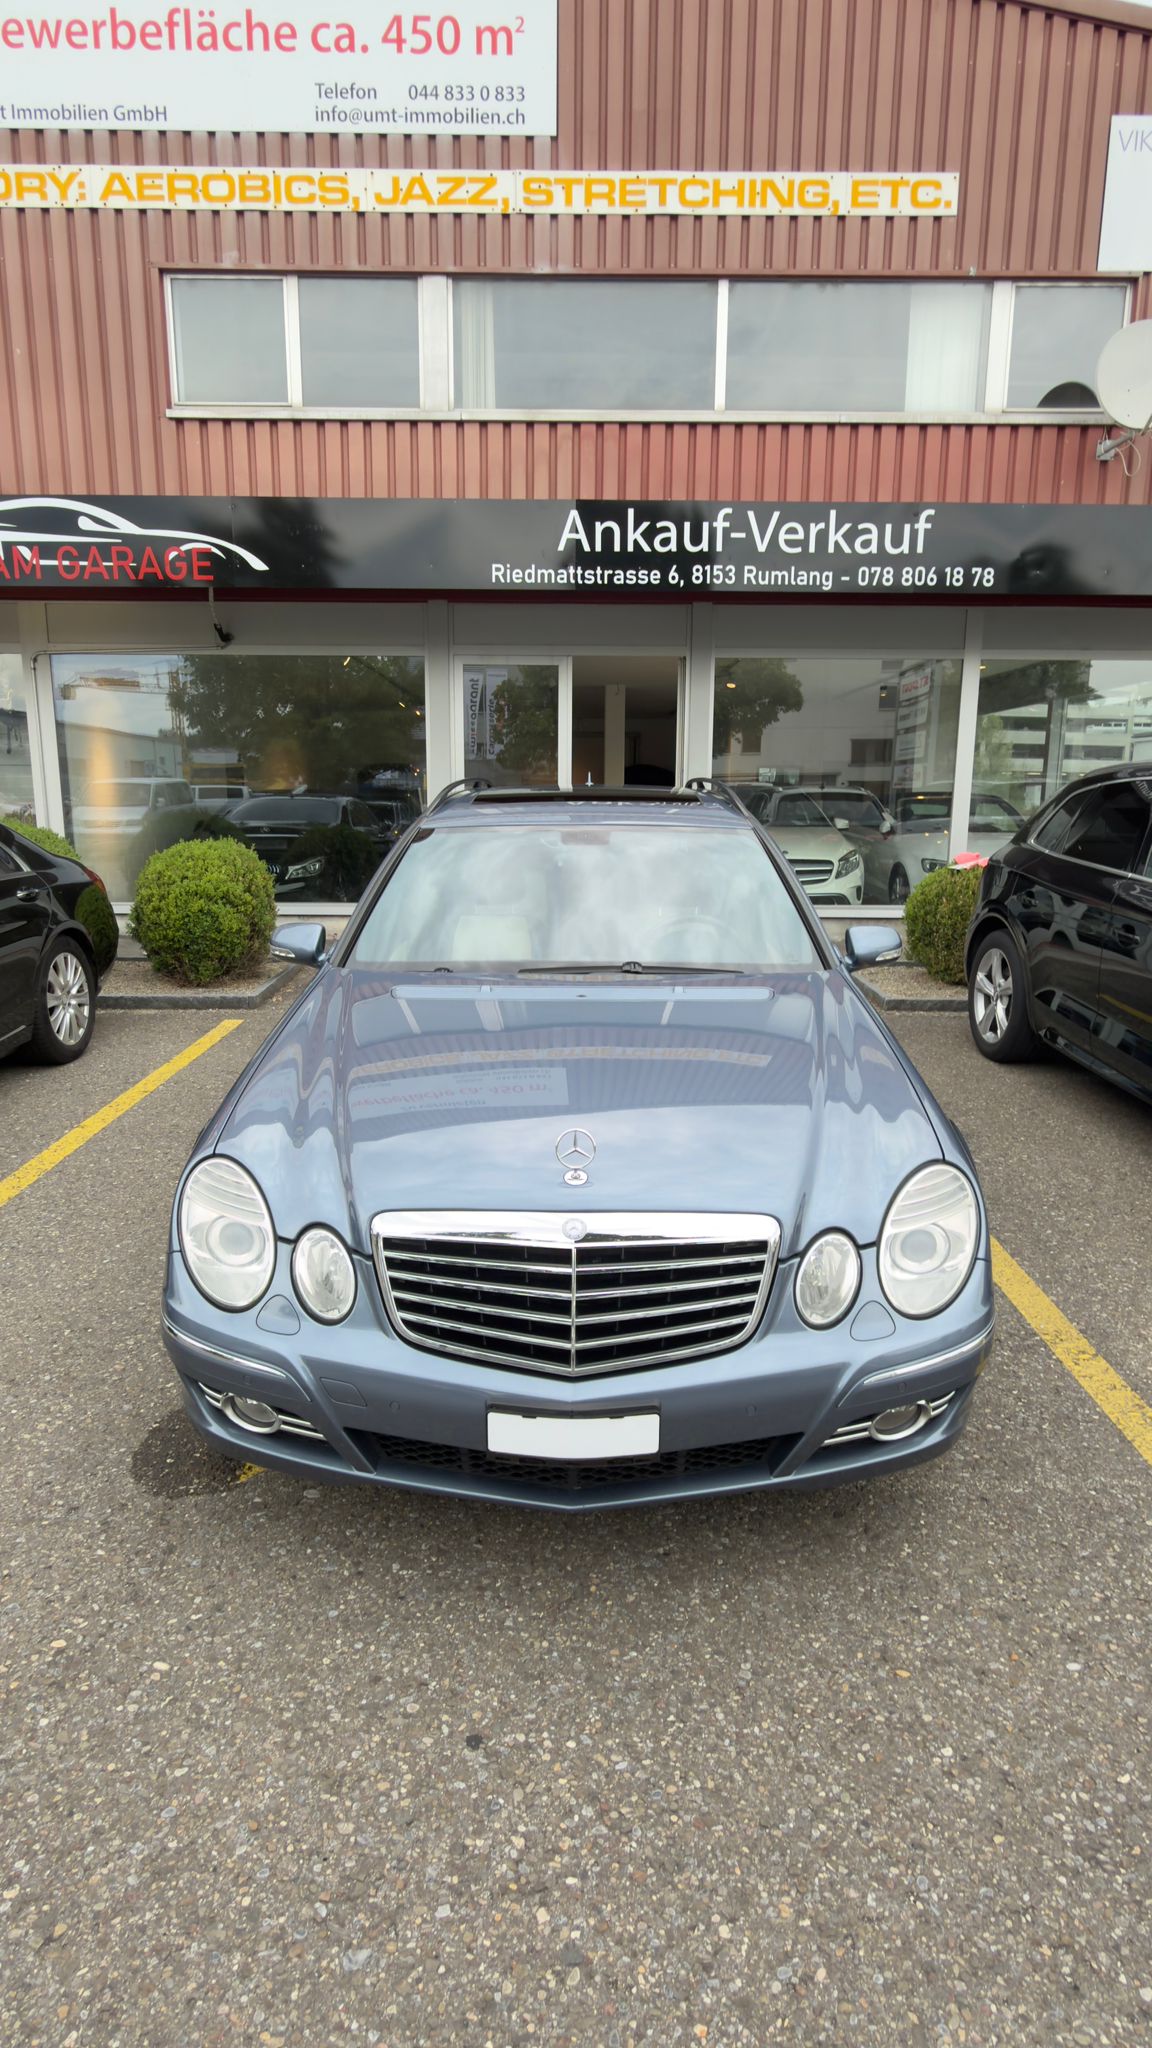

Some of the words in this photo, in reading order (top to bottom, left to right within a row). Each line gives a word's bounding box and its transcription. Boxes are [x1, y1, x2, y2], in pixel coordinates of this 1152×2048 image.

[1, 7, 298, 53] ewerbefläche
[311, 22, 369, 54] ca.
[381, 15, 462, 56] 450
[314, 81, 378, 100] Telefon
[408, 84, 440, 101] 044
[444, 84, 475, 102] 833
[479, 85, 490, 102] 0
[494, 85, 526, 103] 833
[11, 103, 109, 121] Immobilien
[113, 104, 168, 122] GmbH
[315, 104, 526, 125] info@umt-immobilien.ch
[100, 172, 360, 212] AEROBICS,
[374, 175, 510, 214] JAZZ,
[522, 177, 840, 216] STRETCHING,
[850, 179, 952, 209] ETC.
[557, 507, 936, 555] Ankauf-Verkauf
[56, 545, 215, 582] GARAGE
[491, 563, 661, 585] Riedmattstrasse
[668, 564, 684, 588] 6,
[691, 564, 736, 585] 8153
[743, 564, 833, 591] Rumlang
[857, 565, 894, 587] 078
[901, 565, 938, 587] 806
[944, 566, 964, 587] 18
[971, 566, 995, 587] 78
